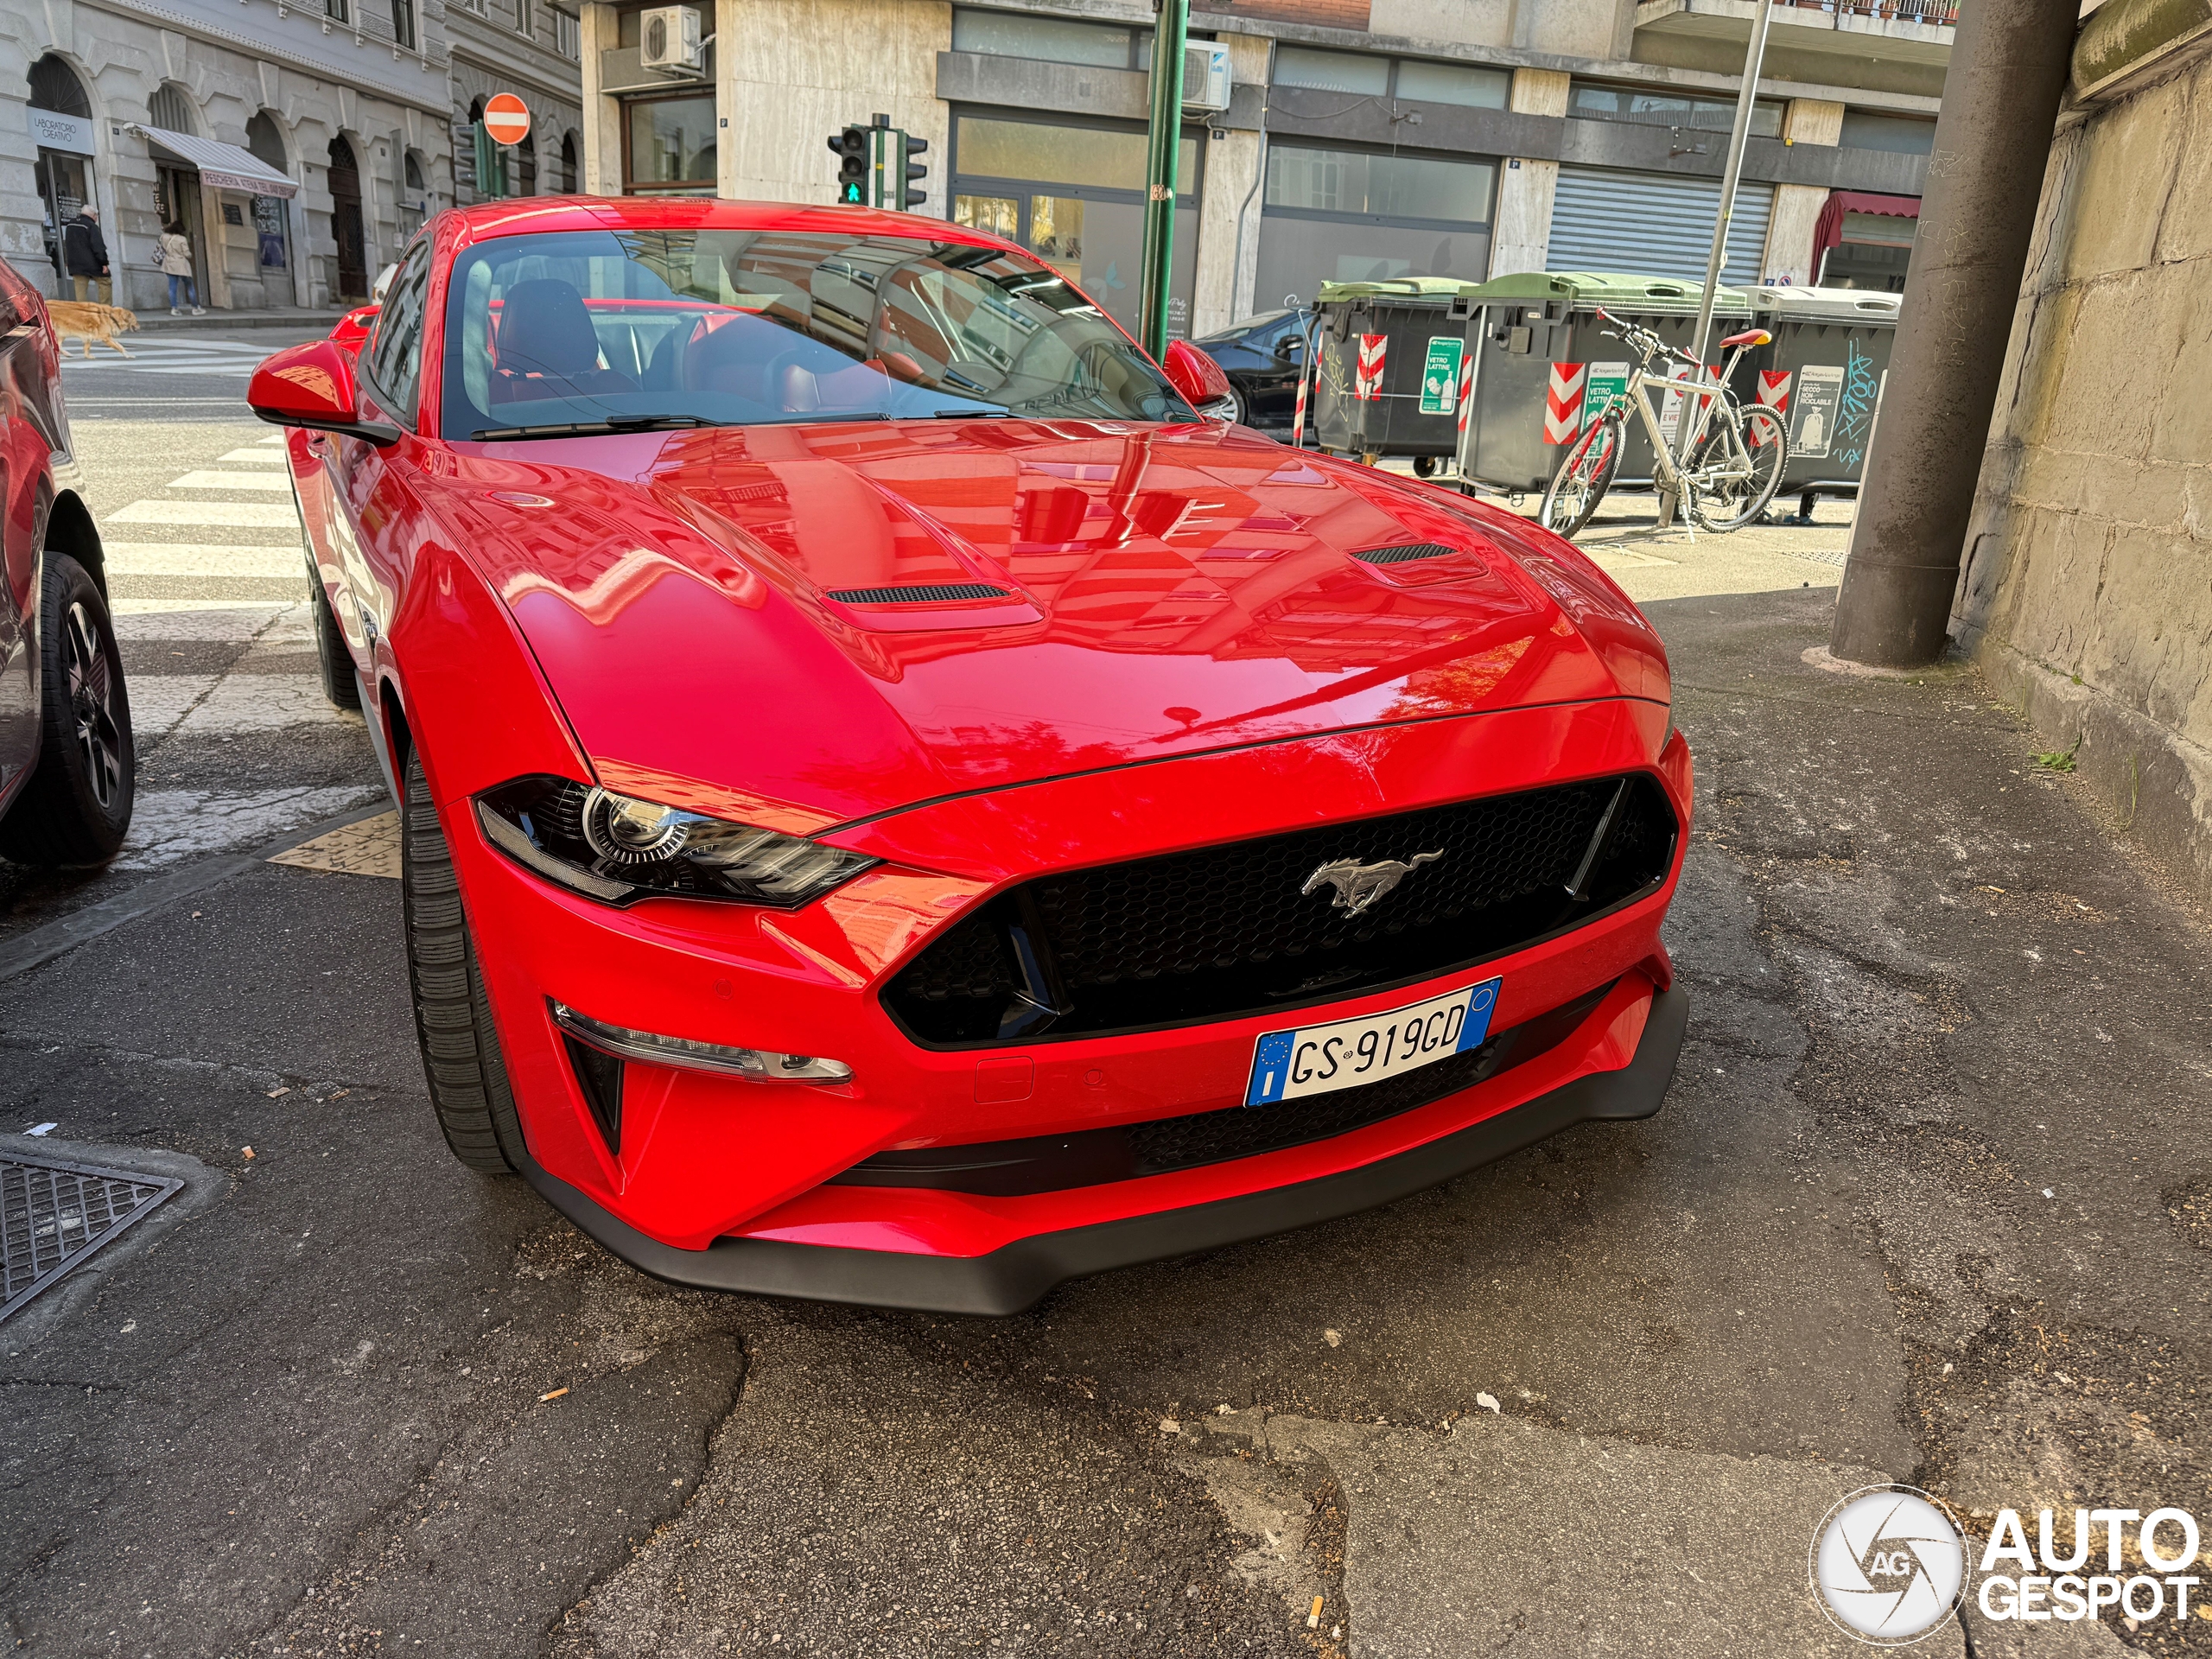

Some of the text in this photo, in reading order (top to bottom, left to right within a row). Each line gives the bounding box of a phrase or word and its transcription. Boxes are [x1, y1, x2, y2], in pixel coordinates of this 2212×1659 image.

[34, 118, 76, 134] LABORATORIO
[41, 129, 72, 142] CREATIVO
[205, 173, 241, 188] PESCHERIA
